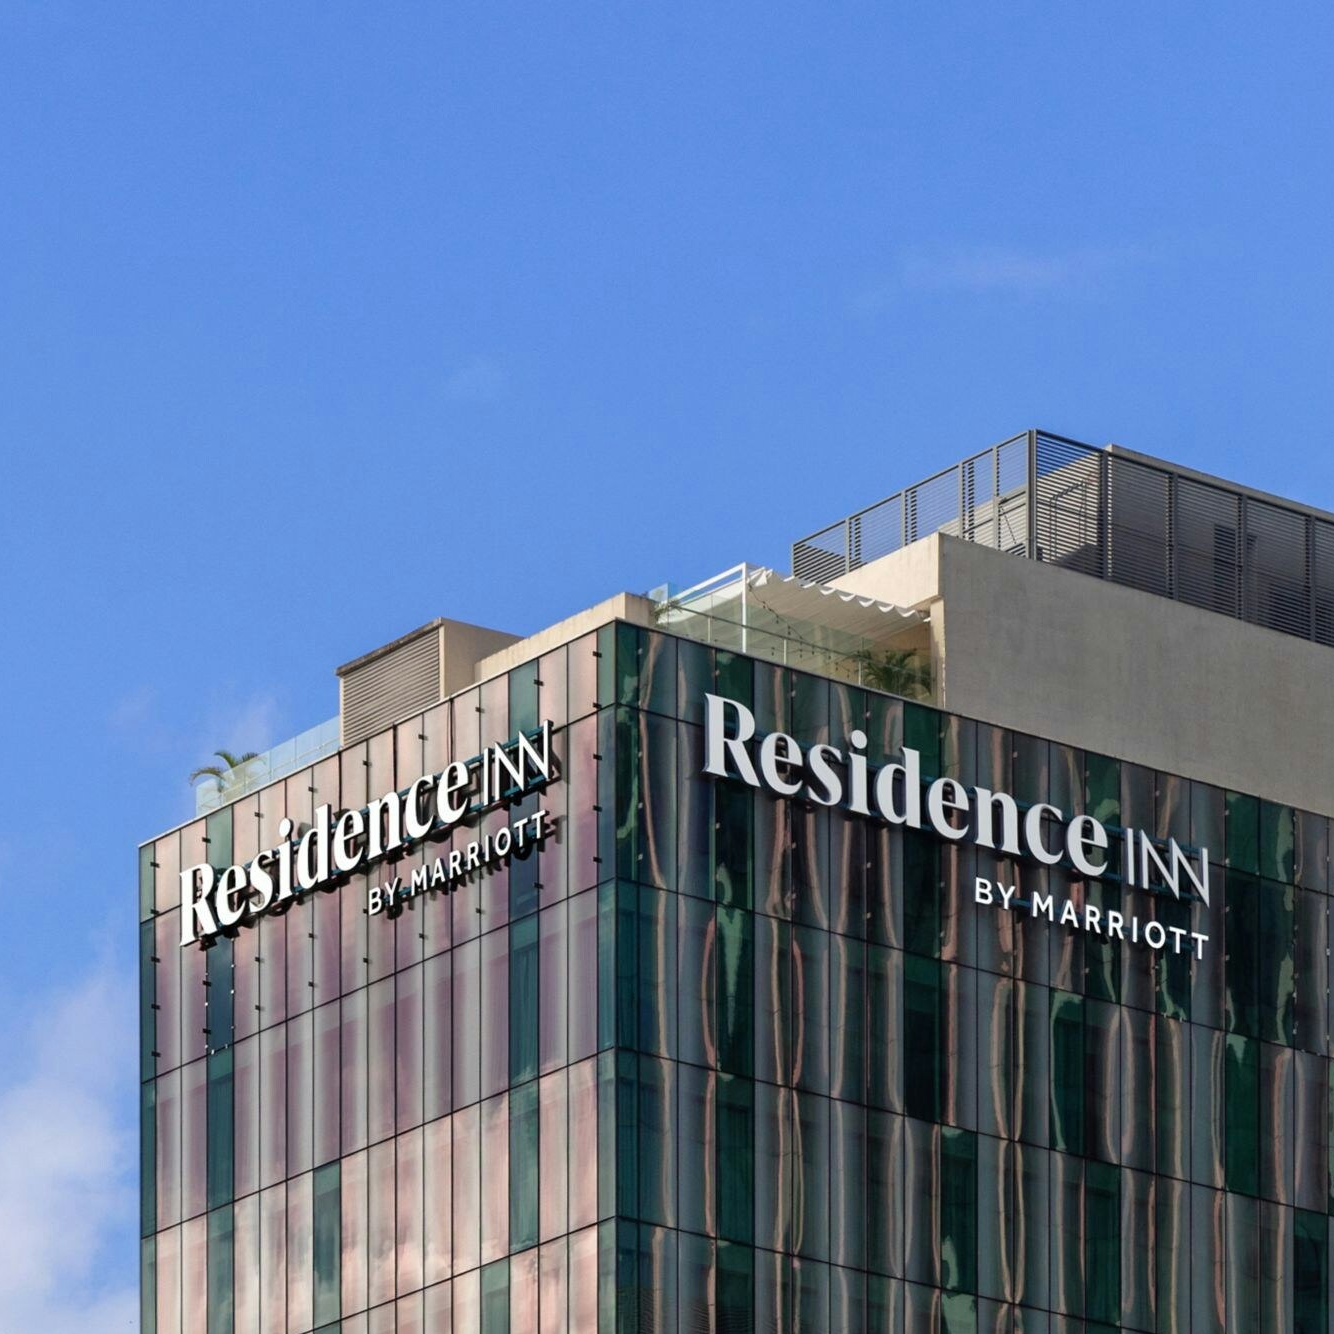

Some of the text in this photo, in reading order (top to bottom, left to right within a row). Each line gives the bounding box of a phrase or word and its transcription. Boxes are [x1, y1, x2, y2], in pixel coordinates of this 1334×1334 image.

[179, 719, 553, 947] Residence INN
[368, 809, 548, 917] BY MARRIOTT
[703, 692, 1210, 908] Residence INN
[974, 876, 1210, 961] BY MARRIOTT
